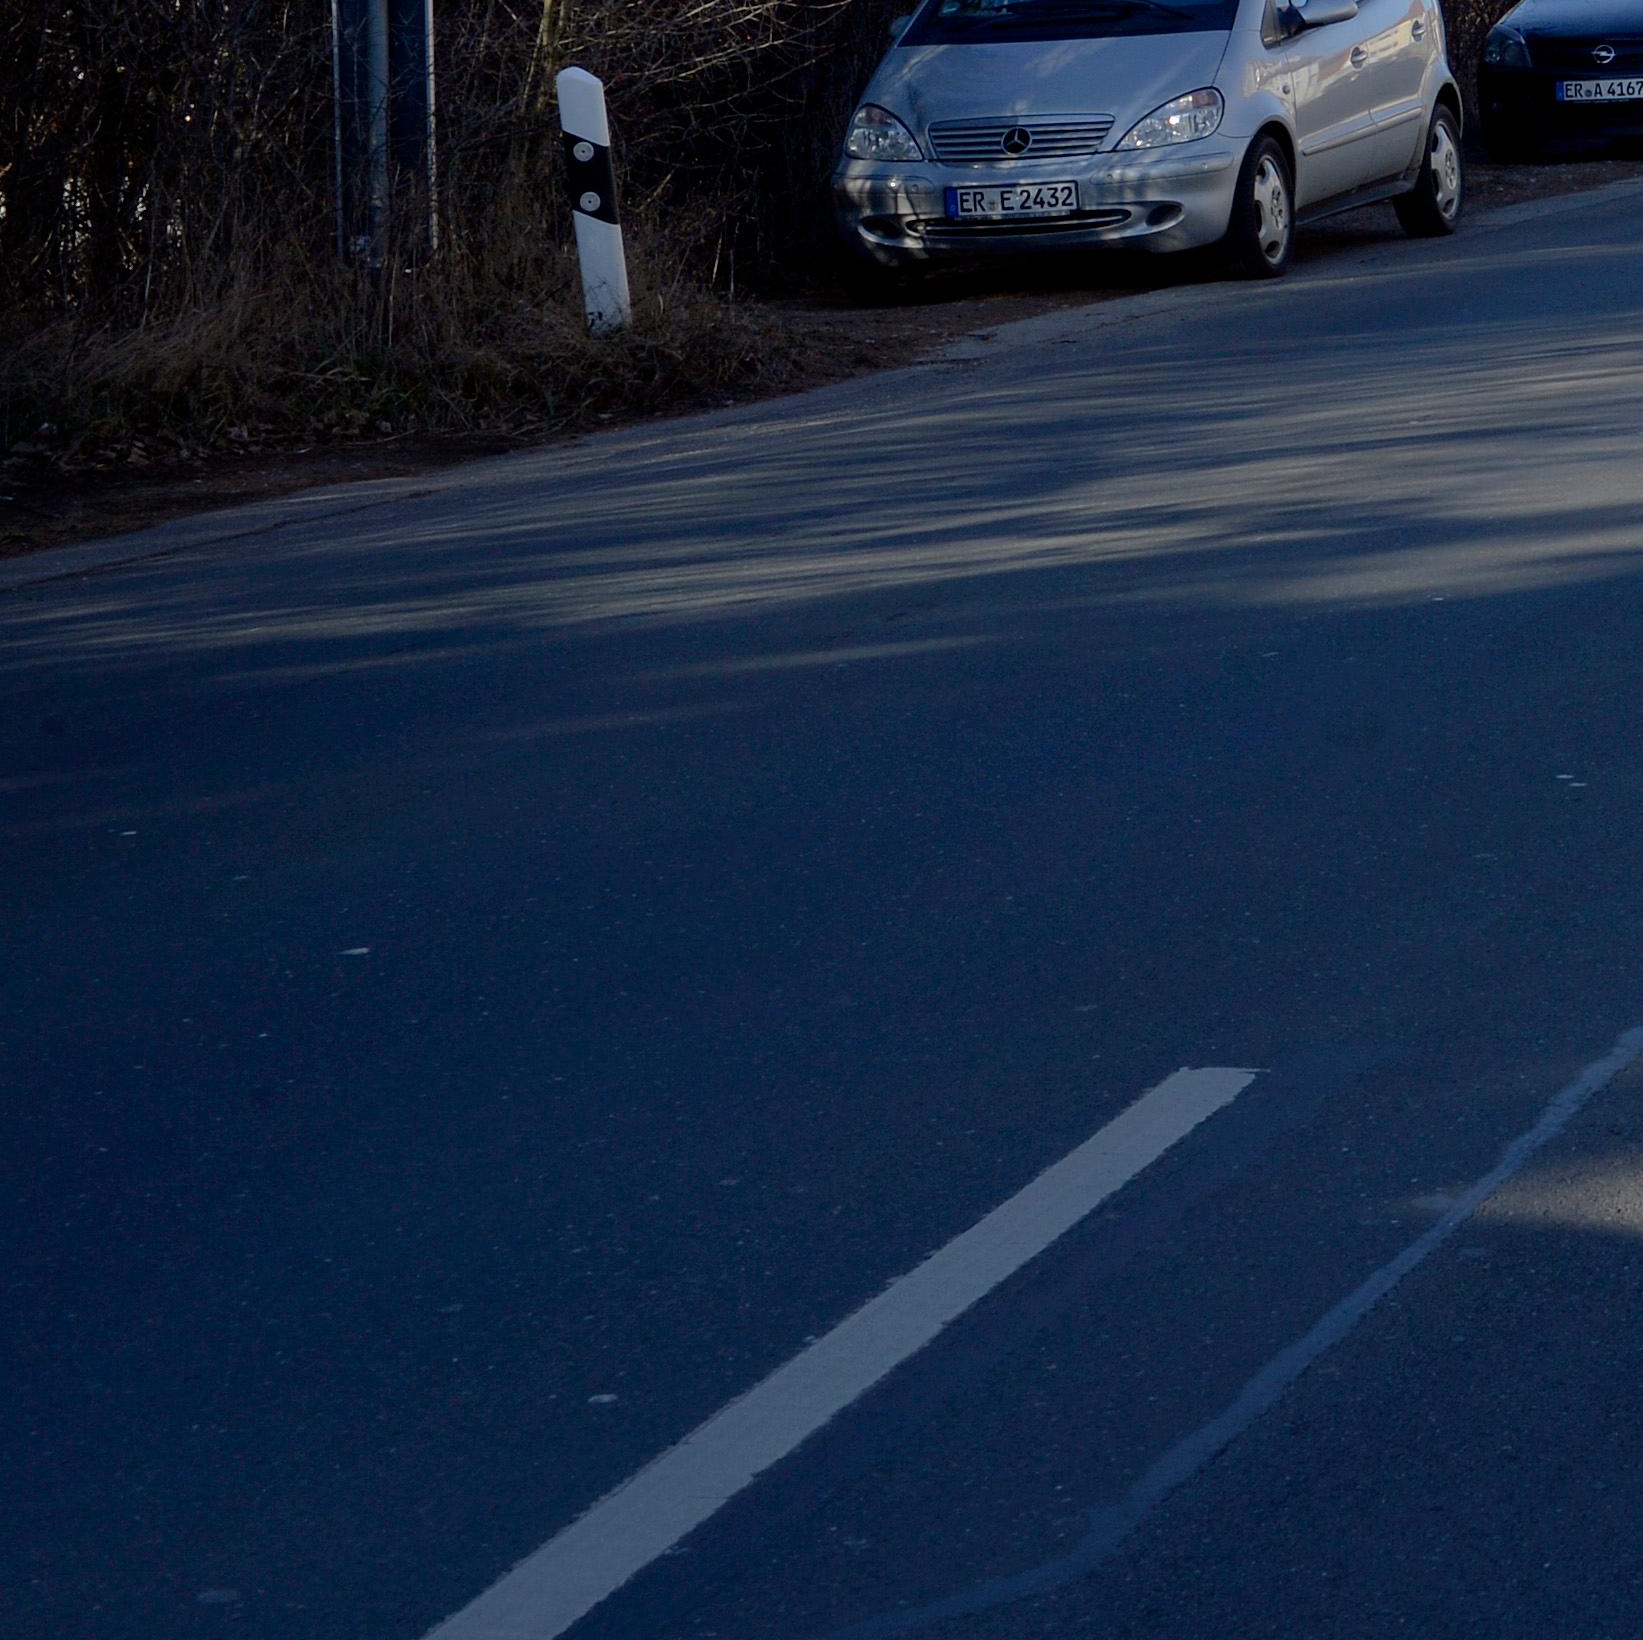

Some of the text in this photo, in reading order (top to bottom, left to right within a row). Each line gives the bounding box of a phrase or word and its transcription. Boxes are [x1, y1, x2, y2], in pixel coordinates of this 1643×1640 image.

[1565, 83, 1583, 98] ER
[1594, 83, 1603, 97] A
[959, 186, 1073, 213] ER E 2432
